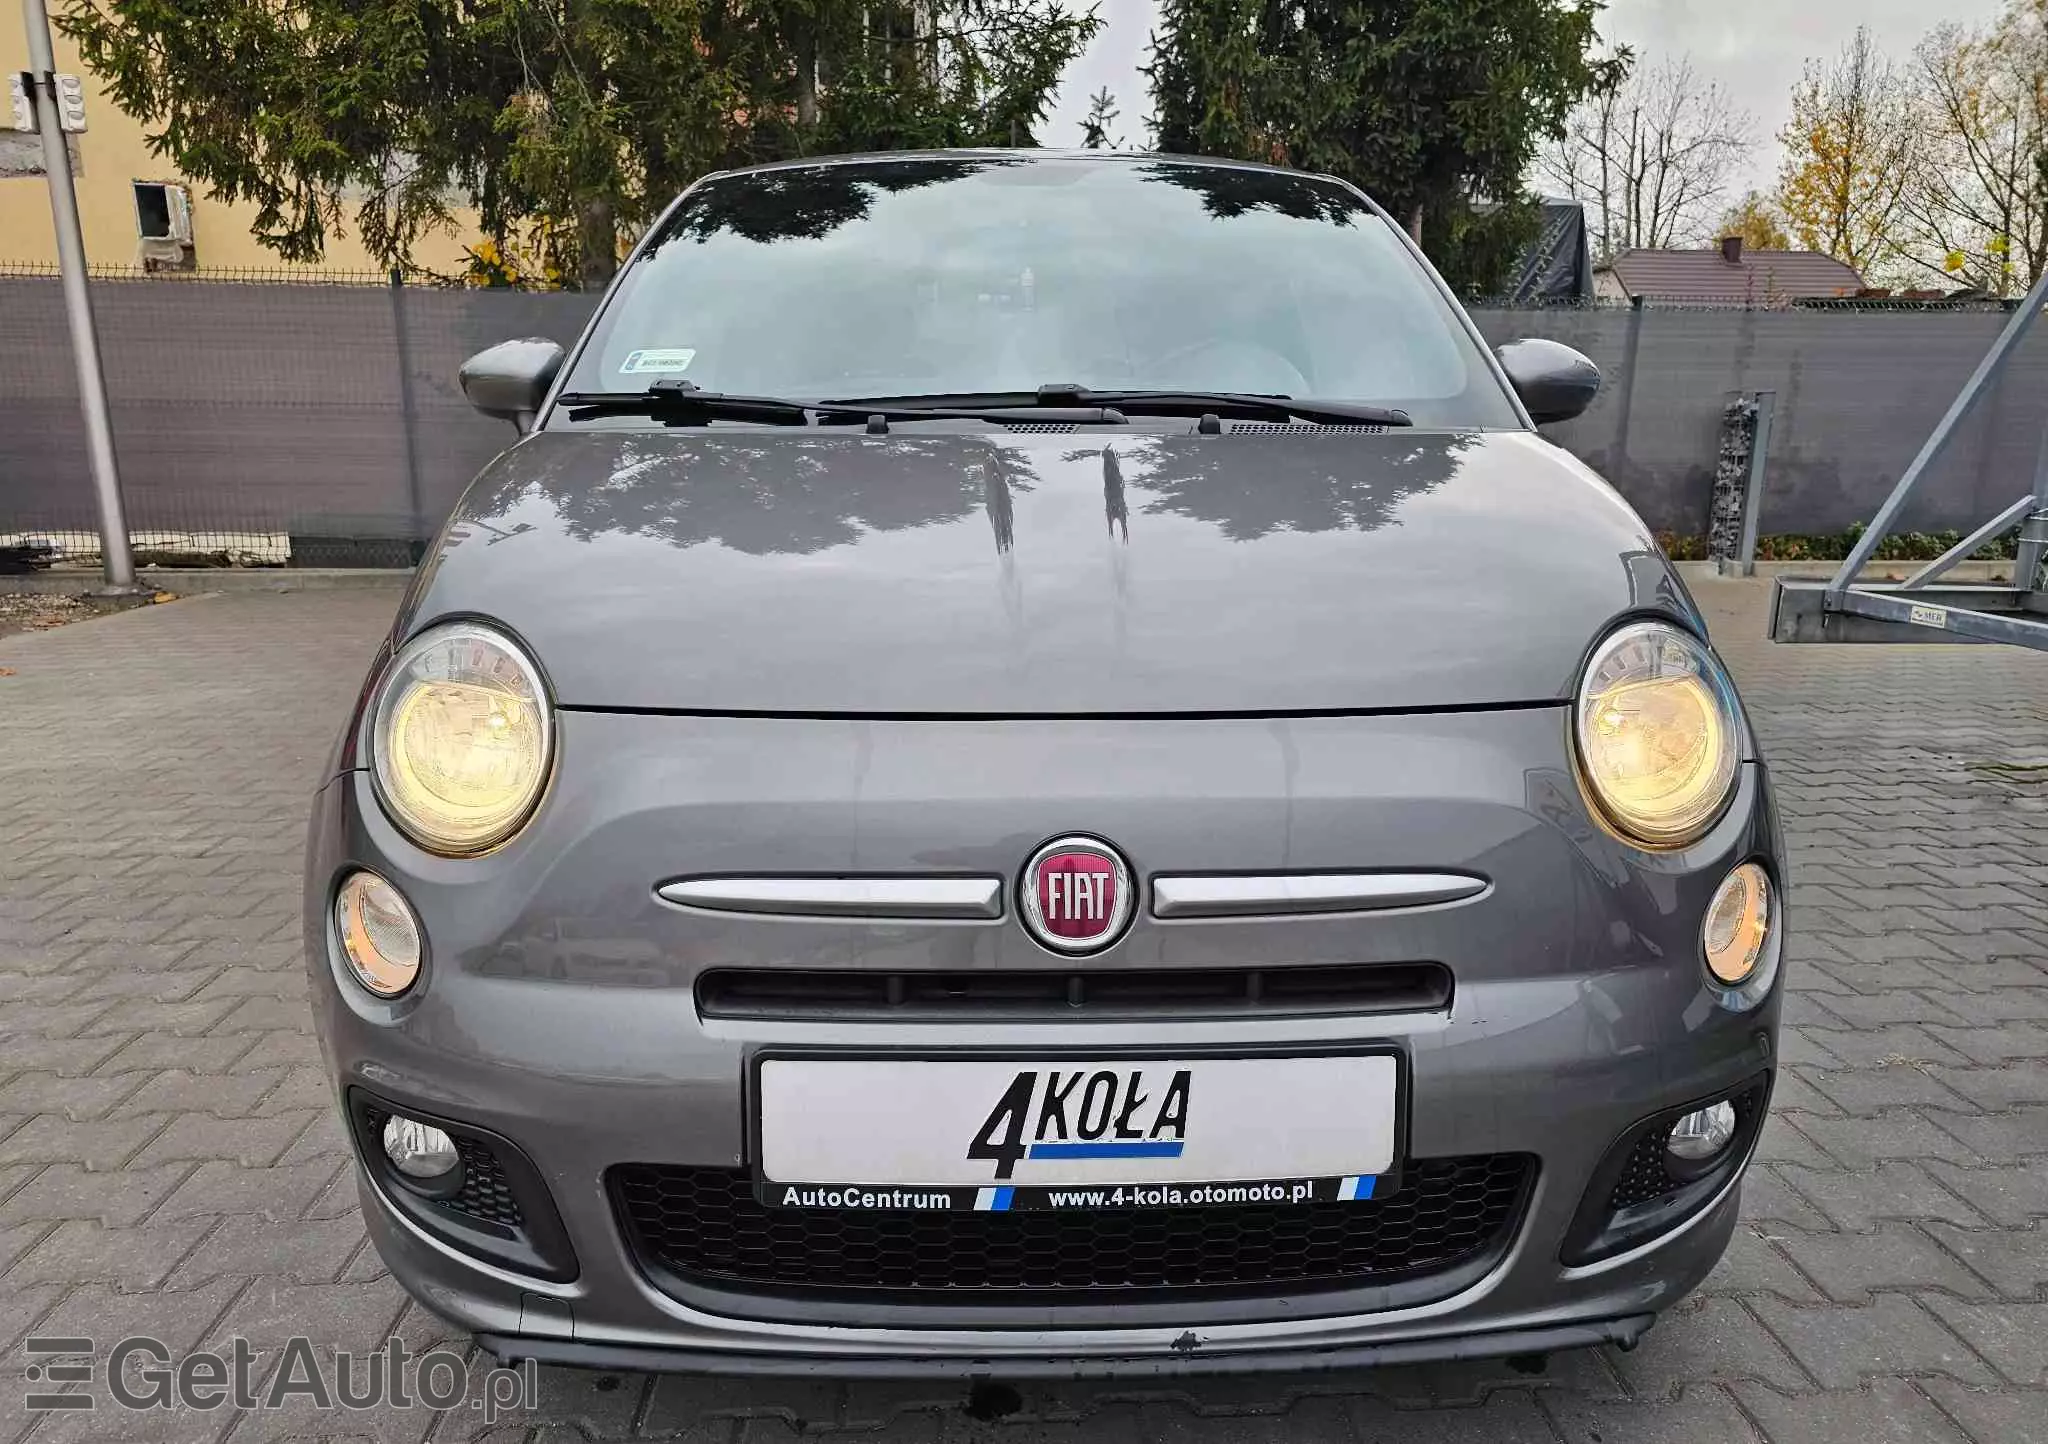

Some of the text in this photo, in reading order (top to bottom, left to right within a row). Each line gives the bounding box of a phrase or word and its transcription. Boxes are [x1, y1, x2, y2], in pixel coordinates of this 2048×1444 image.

[1047, 871, 1110, 920] FIAT
[782, 1185, 952, 1210] AutoCentrum
[1048, 1181, 1315, 1208] www.4-kola.otomoto.pl
